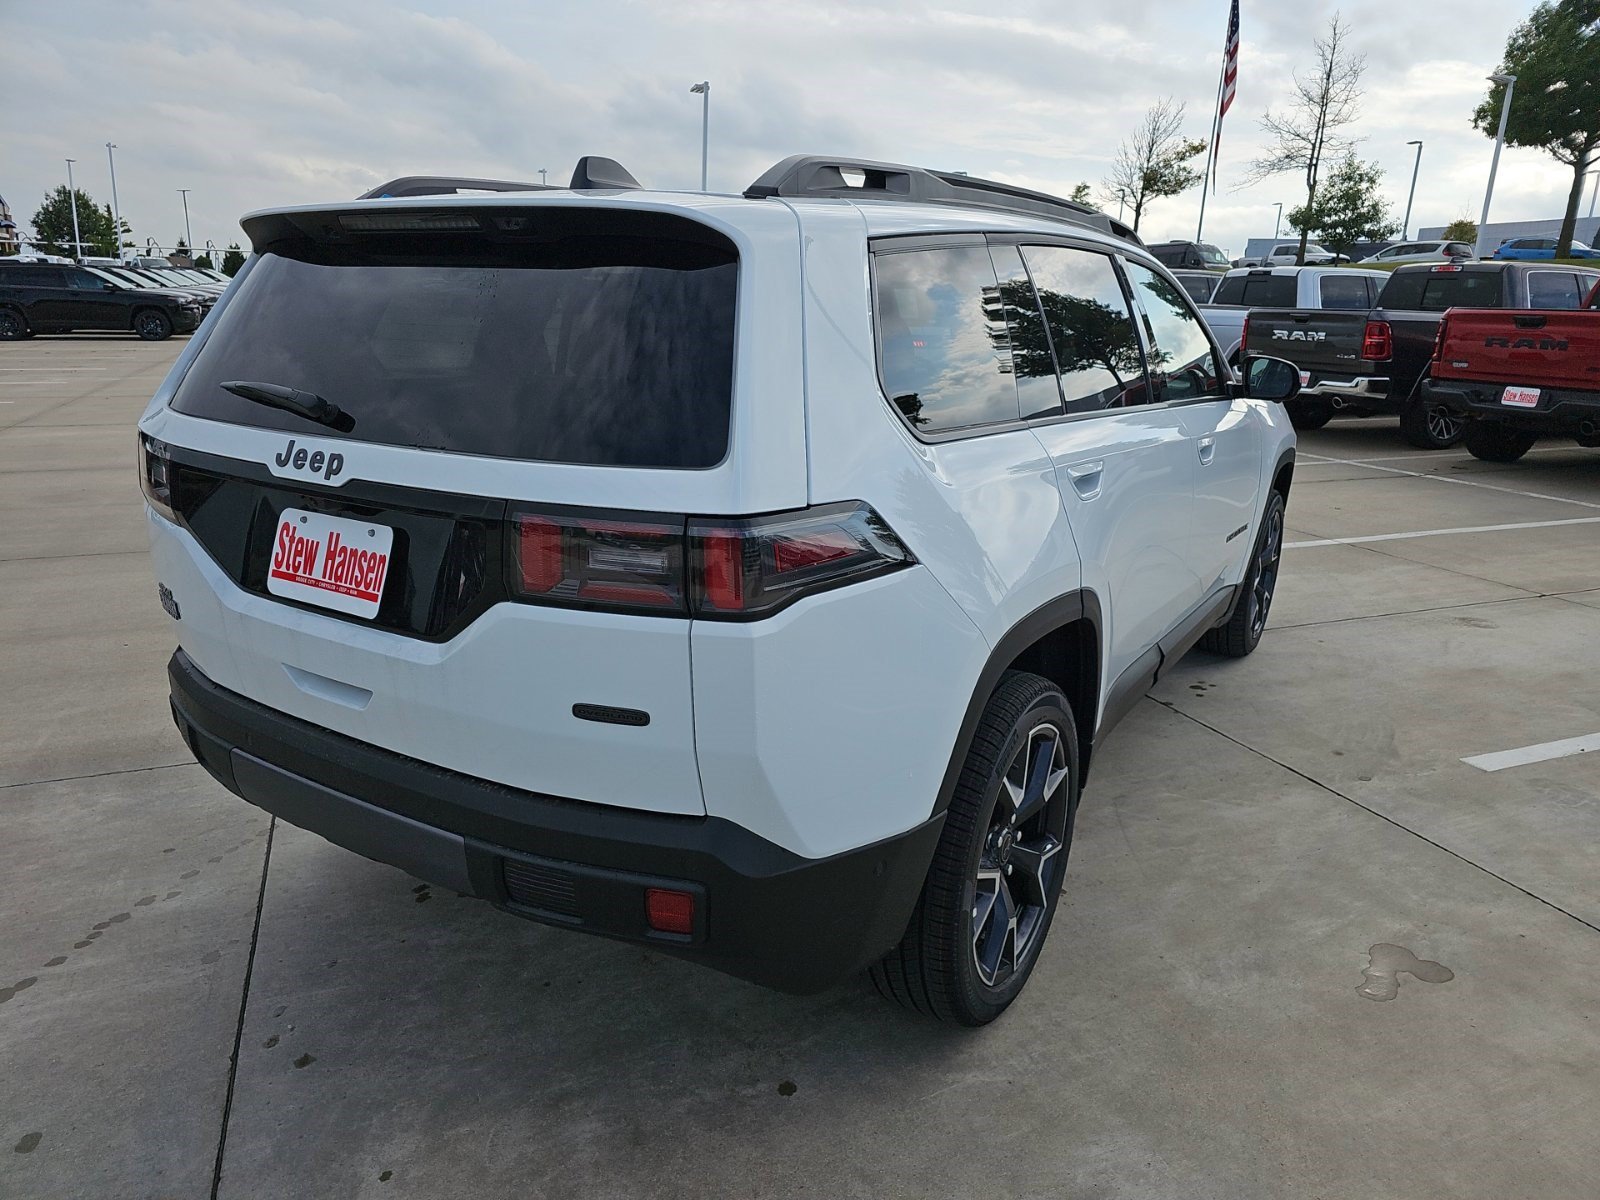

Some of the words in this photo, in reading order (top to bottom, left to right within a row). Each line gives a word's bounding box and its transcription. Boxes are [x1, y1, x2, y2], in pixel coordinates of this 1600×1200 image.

[1272, 329, 1326, 342] RAM
[1485, 336, 1569, 351] RAM
[1503, 389, 1517, 402] Stew
[1519, 391, 1539, 404] Hansen
[275, 439, 344, 481] Jeep
[274, 521, 320, 577] Stew
[322, 531, 387, 593] Hansen
